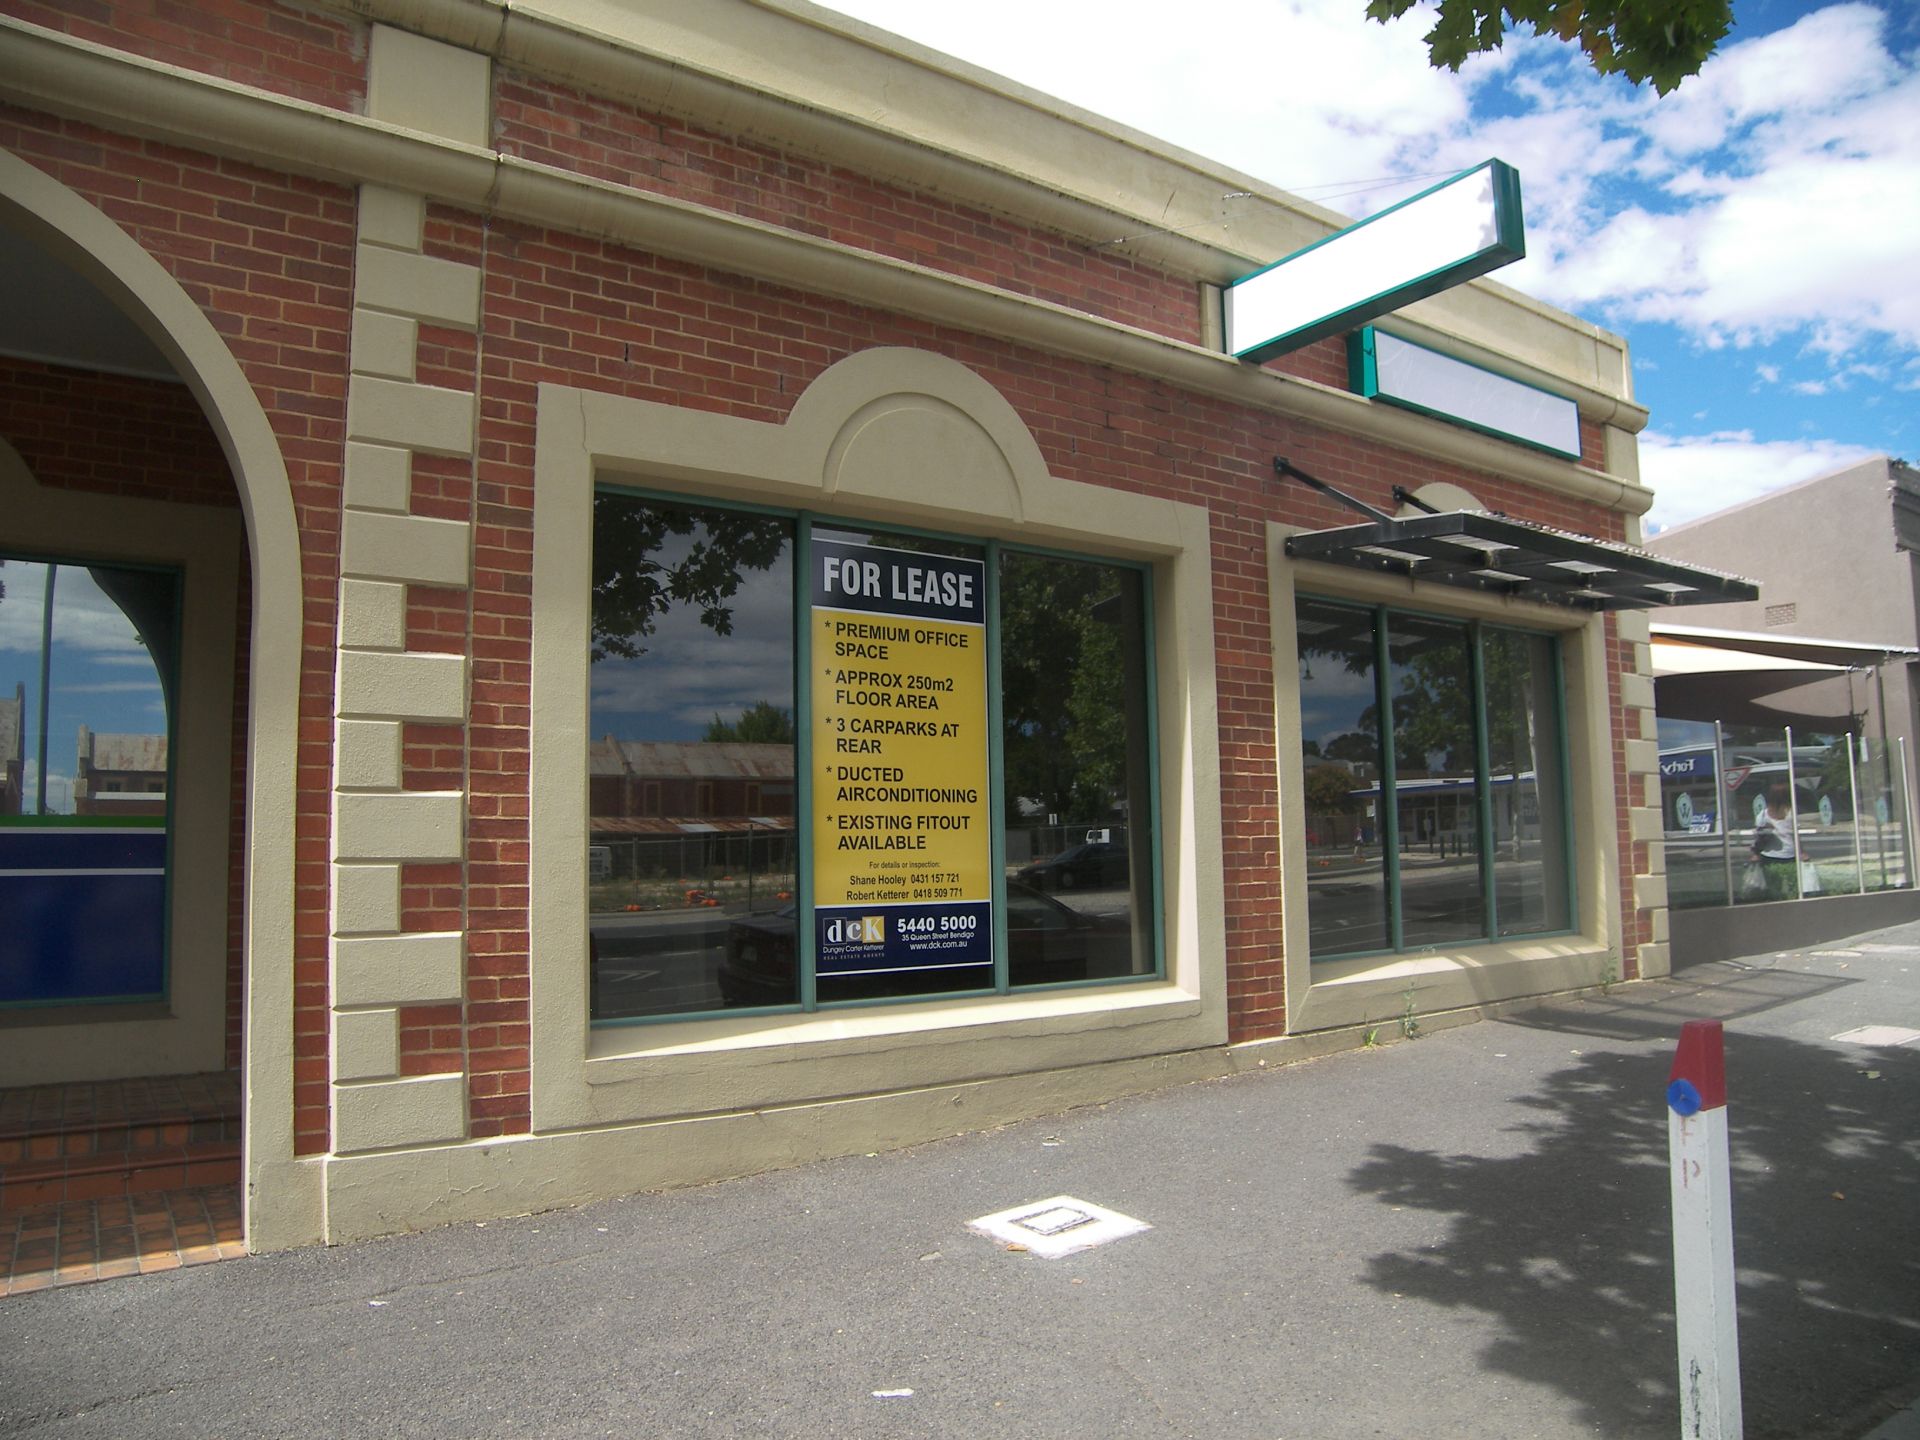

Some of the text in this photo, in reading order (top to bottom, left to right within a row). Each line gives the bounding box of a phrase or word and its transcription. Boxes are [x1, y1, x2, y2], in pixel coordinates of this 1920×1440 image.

[823, 556, 973, 608] FOR LEASE
[836, 622, 968, 648] PREMIUM OFFICE
[835, 642, 888, 660] SPACE
[835, 669, 953, 692] APPROX 250m2
[836, 690, 939, 710] FLOOR AREA
[836, 717, 959, 738] 3 CARPARKS AT
[836, 738, 882, 754] REAR
[837, 766, 904, 782] DUCTED
[837, 786, 977, 803] AIRCONDITIONING
[838, 815, 970, 830] EXISTING FITOUT
[838, 835, 926, 850] AVAILABLE
[869, 861, 879, 869] For
[880, 861, 900, 869] details
[850, 873, 960, 886] Shane Hooley 0431 157 721
[846, 888, 963, 901] Robert Ketterer 0418 509 771
[897, 915, 977, 933] 5440 5000
[901, 931, 975, 942] 35 Queen Street Bendigo
[909, 940, 968, 951] www.dck.com.au
